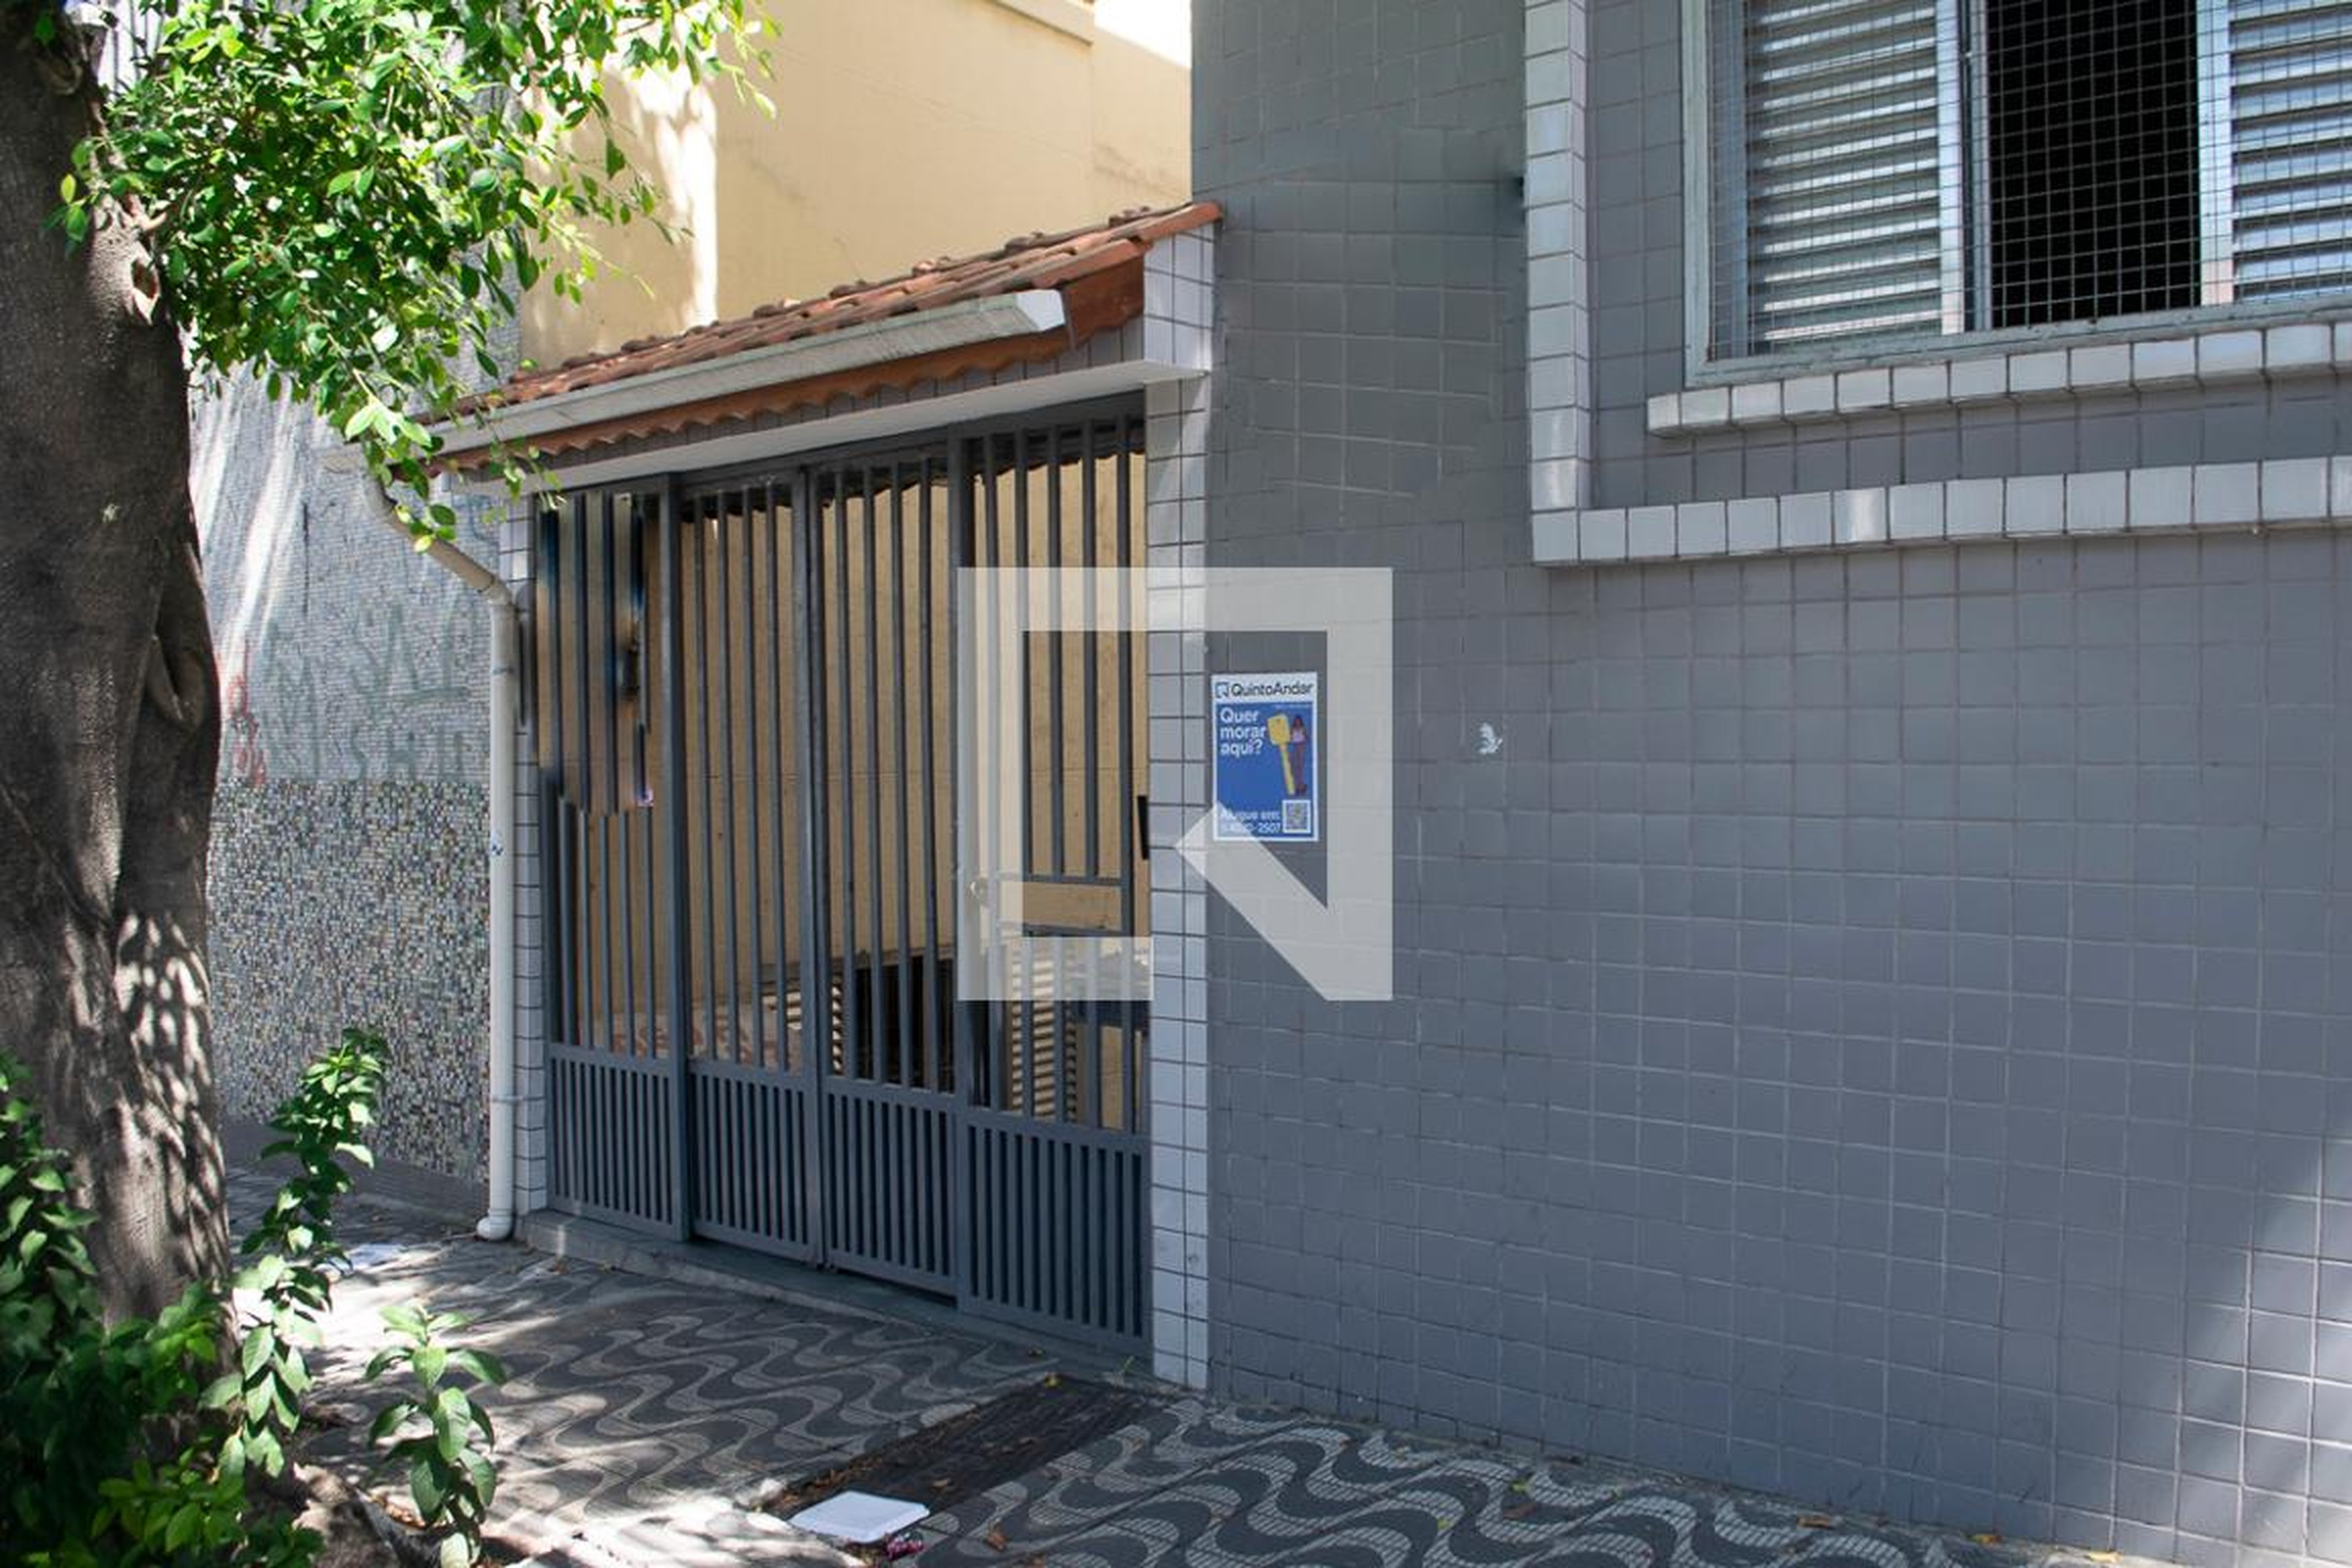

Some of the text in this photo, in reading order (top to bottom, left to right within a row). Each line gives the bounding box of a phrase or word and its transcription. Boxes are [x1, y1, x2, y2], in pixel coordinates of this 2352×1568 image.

[1231, 680, 1313, 696] QuintoAndar
[1219, 707, 1259, 723] Quer
[1219, 726, 1266, 739] morar
[1219, 739, 1263, 758] aqui?
